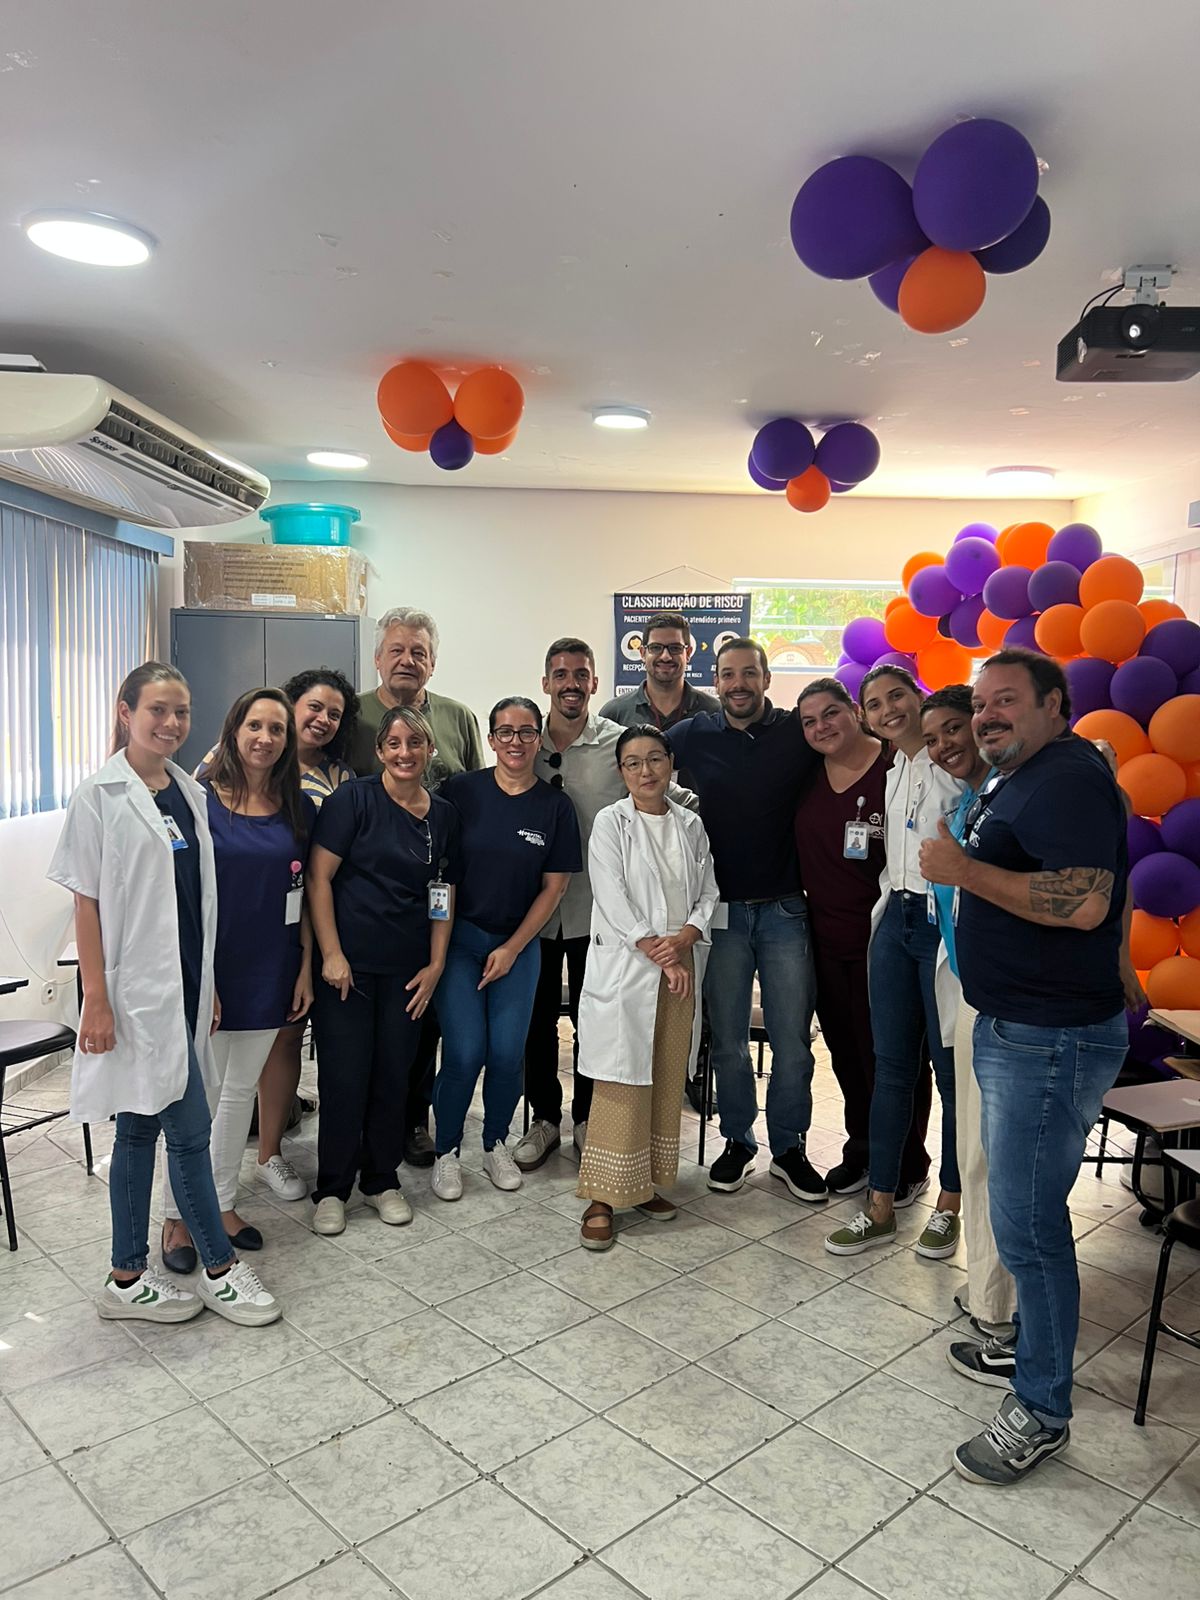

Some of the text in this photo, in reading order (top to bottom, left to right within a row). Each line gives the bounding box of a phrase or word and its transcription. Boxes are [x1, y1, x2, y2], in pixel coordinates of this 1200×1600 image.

[622, 593, 743, 610] CLASSIFICAÇÃO DE RISCO
[689, 615, 717, 624] atendidos
[717, 615, 742, 625] primeiro
